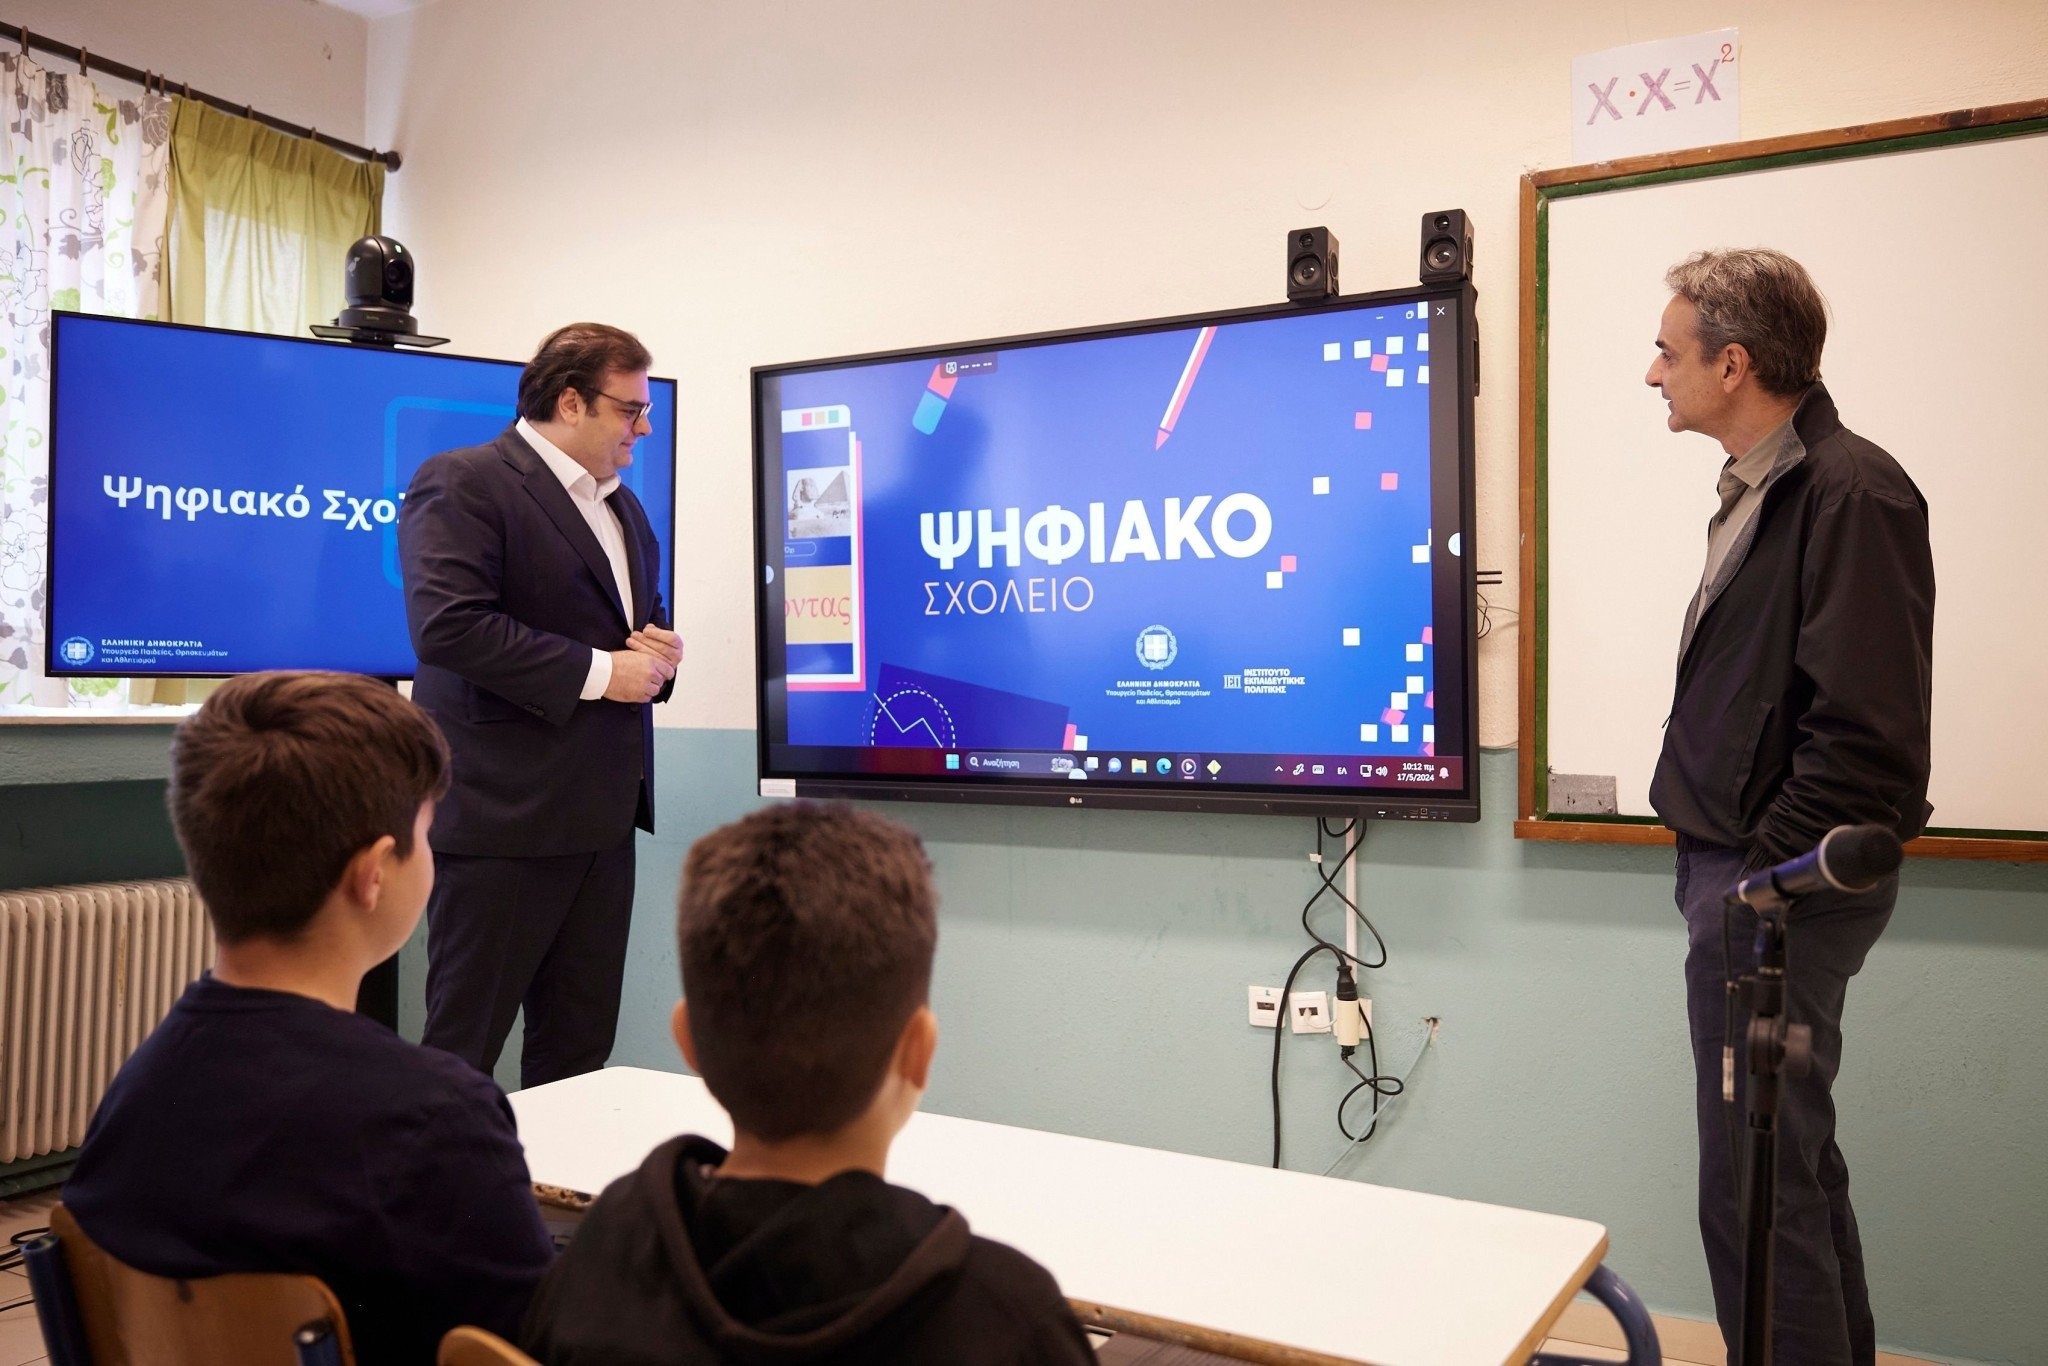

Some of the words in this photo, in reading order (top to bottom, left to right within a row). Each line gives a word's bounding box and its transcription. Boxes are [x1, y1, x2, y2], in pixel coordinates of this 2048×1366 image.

[103, 474, 310, 522] Ψηφιακό
[322, 489, 406, 531] Σχο
[920, 492, 1273, 570] ΨΗΦΙΑΚΟ
[924, 576, 1094, 615] ΣΧΟΛΕΙΟ
[101, 639, 145, 647] ΕΛΛΗΝΙΚΗ
[147, 640, 203, 648] ΔΗΜΟΚΡΑΤΙΑ
[1243, 668, 1291, 676] ΙΝΣΤΙΤΟΥΤΟ
[1116, 680, 1152, 688] ΕΛΛΗΝΙΚΗ
[1153, 680, 1201, 688] ΔΗΜΟΚΡΑΤΙΑ
[1244, 676, 1306, 685] ΕΚΠΑΙΔΕΥΤΙΚΗΣ
[1244, 685, 1287, 694] ΠΟΛΙΤΙΚΗΣ
[983, 758, 1020, 769] Αναζήτηση
[1402, 762, 1422, 771] 10:12
[1424, 763, 1435, 772] πμ
[1397, 773, 1435, 781] 17/5/2024
